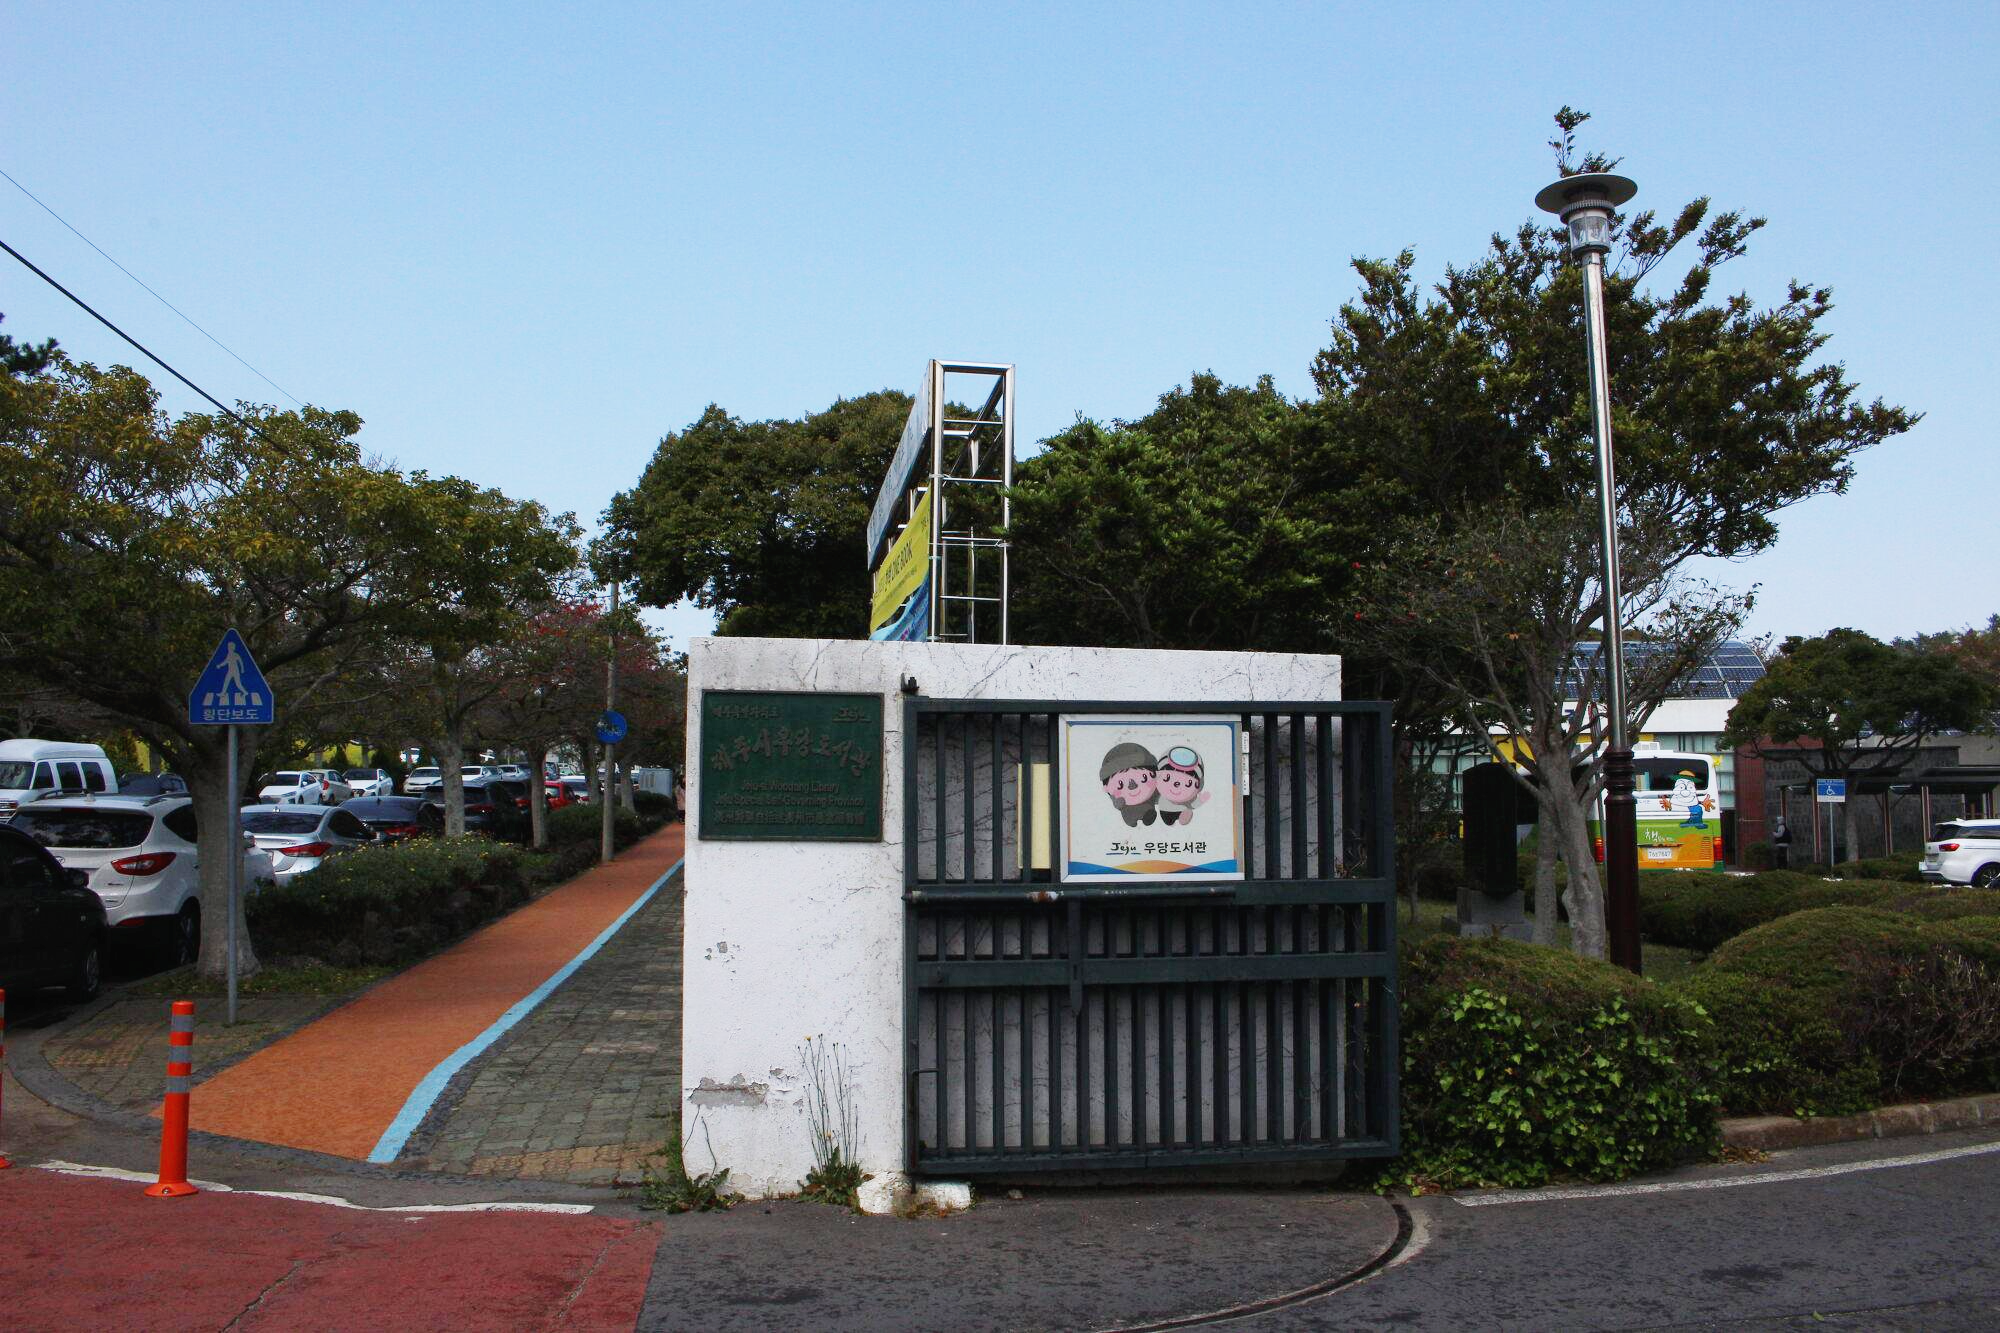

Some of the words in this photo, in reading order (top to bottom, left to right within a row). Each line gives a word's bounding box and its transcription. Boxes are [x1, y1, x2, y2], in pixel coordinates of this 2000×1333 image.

[202, 708, 260, 721] 횡단보도
[1111, 842, 1137, 855] Jeju
[1144, 841, 1207, 854] 우당도서관
